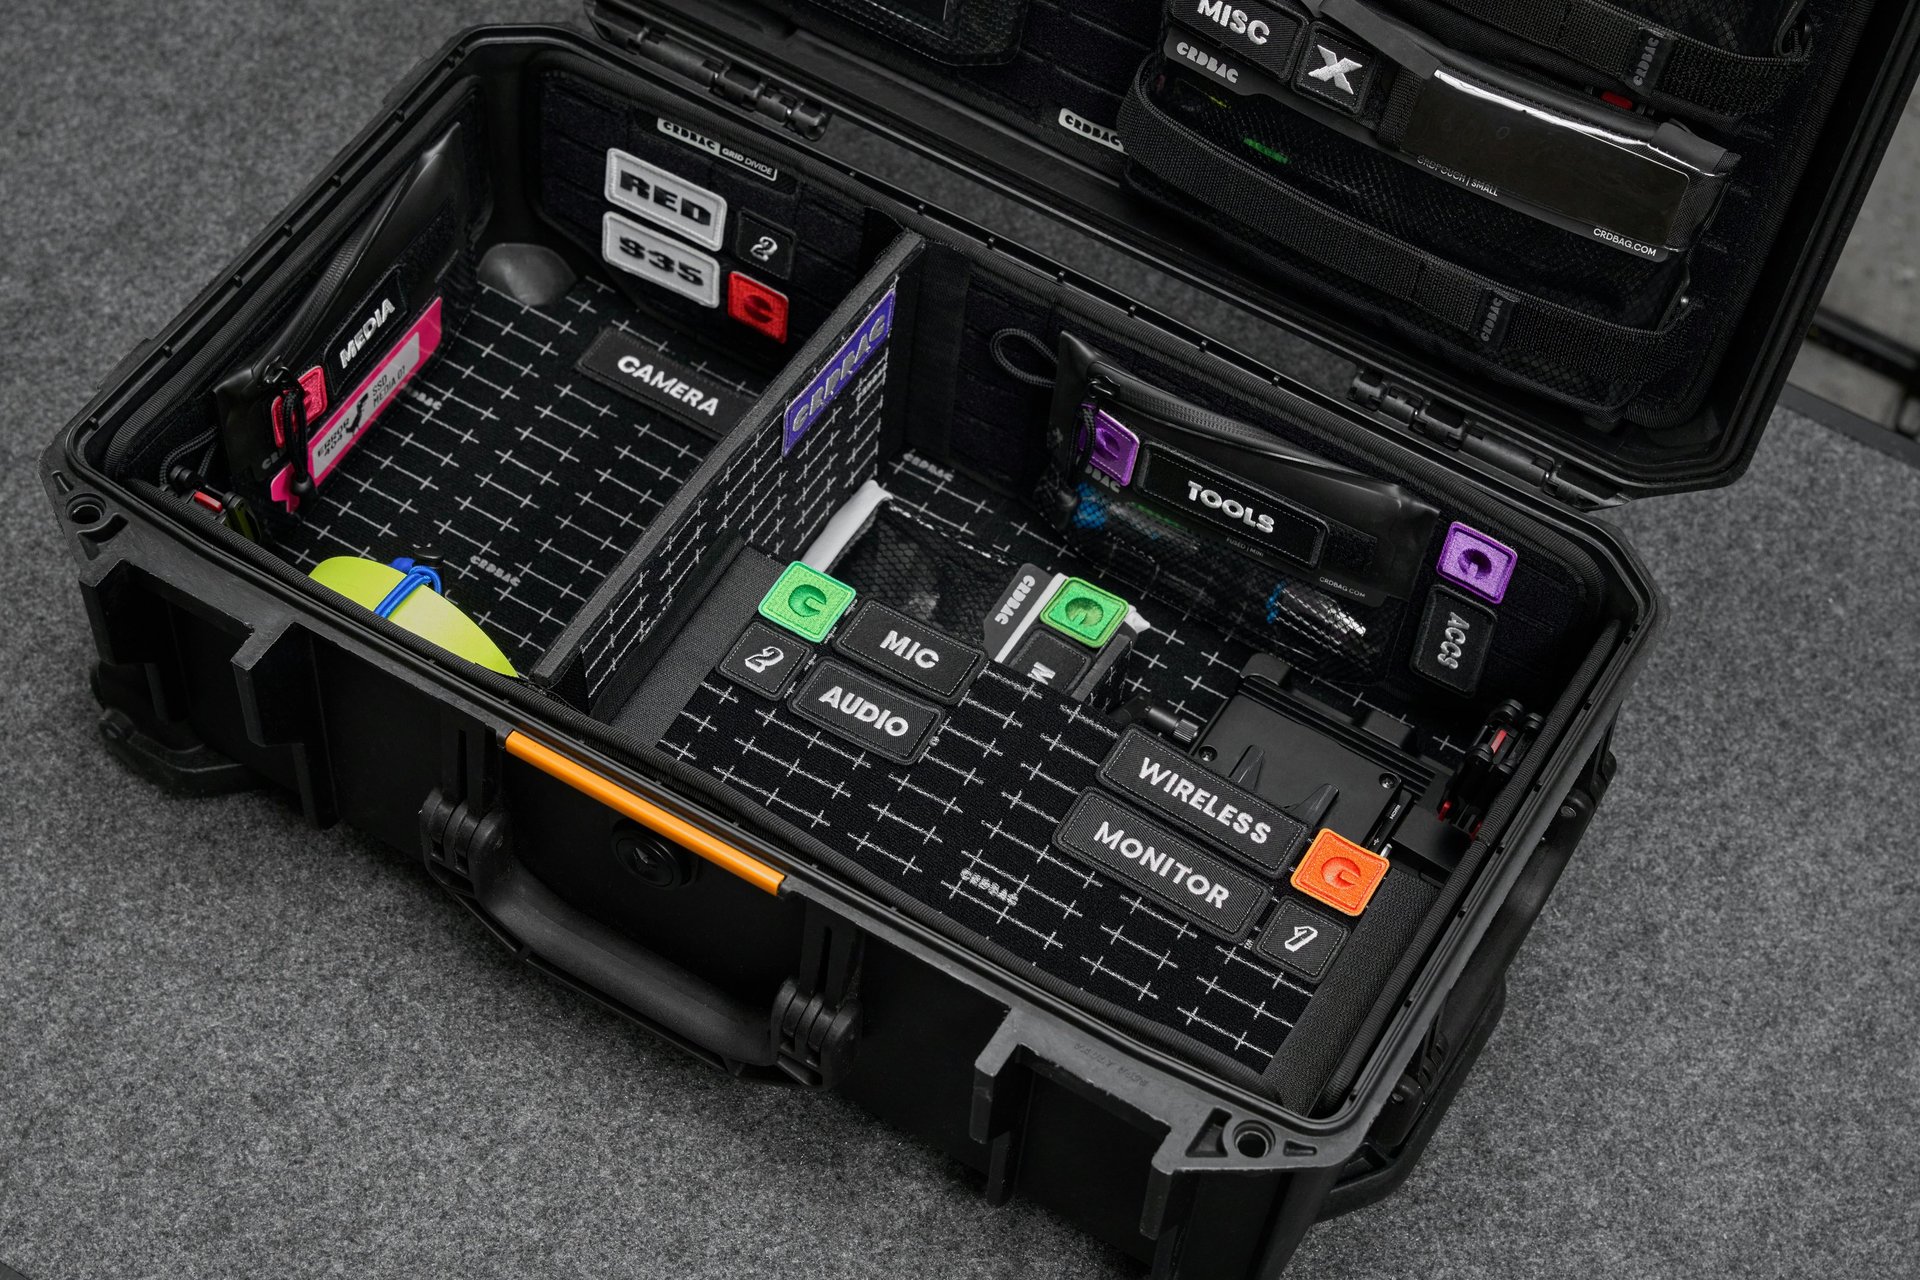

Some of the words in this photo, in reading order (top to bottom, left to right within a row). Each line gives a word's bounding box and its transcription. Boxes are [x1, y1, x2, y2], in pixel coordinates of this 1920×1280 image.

[1197, 0, 1270, 46] MISC
[721, 147, 745, 162] GRID
[744, 157, 774, 176] DIVIDE
[619, 169, 712, 227] RED
[1470, 177, 1498, 197] SMALL
[619, 235, 705, 287] S35
[749, 235, 778, 263] 2
[1593, 227, 1657, 257] CRDBAG.COM
[339, 297, 396, 370] MEDIA
[617, 355, 719, 417] CAMERA
[317, 417, 350, 457] ERROR
[1187, 480, 1275, 534] TOOLS
[744, 646, 785, 674] 2
[879, 629, 940, 669] MIC
[1437, 611, 1470, 670] ACCS
[818, 685, 909, 737] AUDIO
[1138, 756, 1272, 845] WIRELESS
[1093, 820, 1230, 910] MONITOR
[1284, 925, 1319, 953] 1
